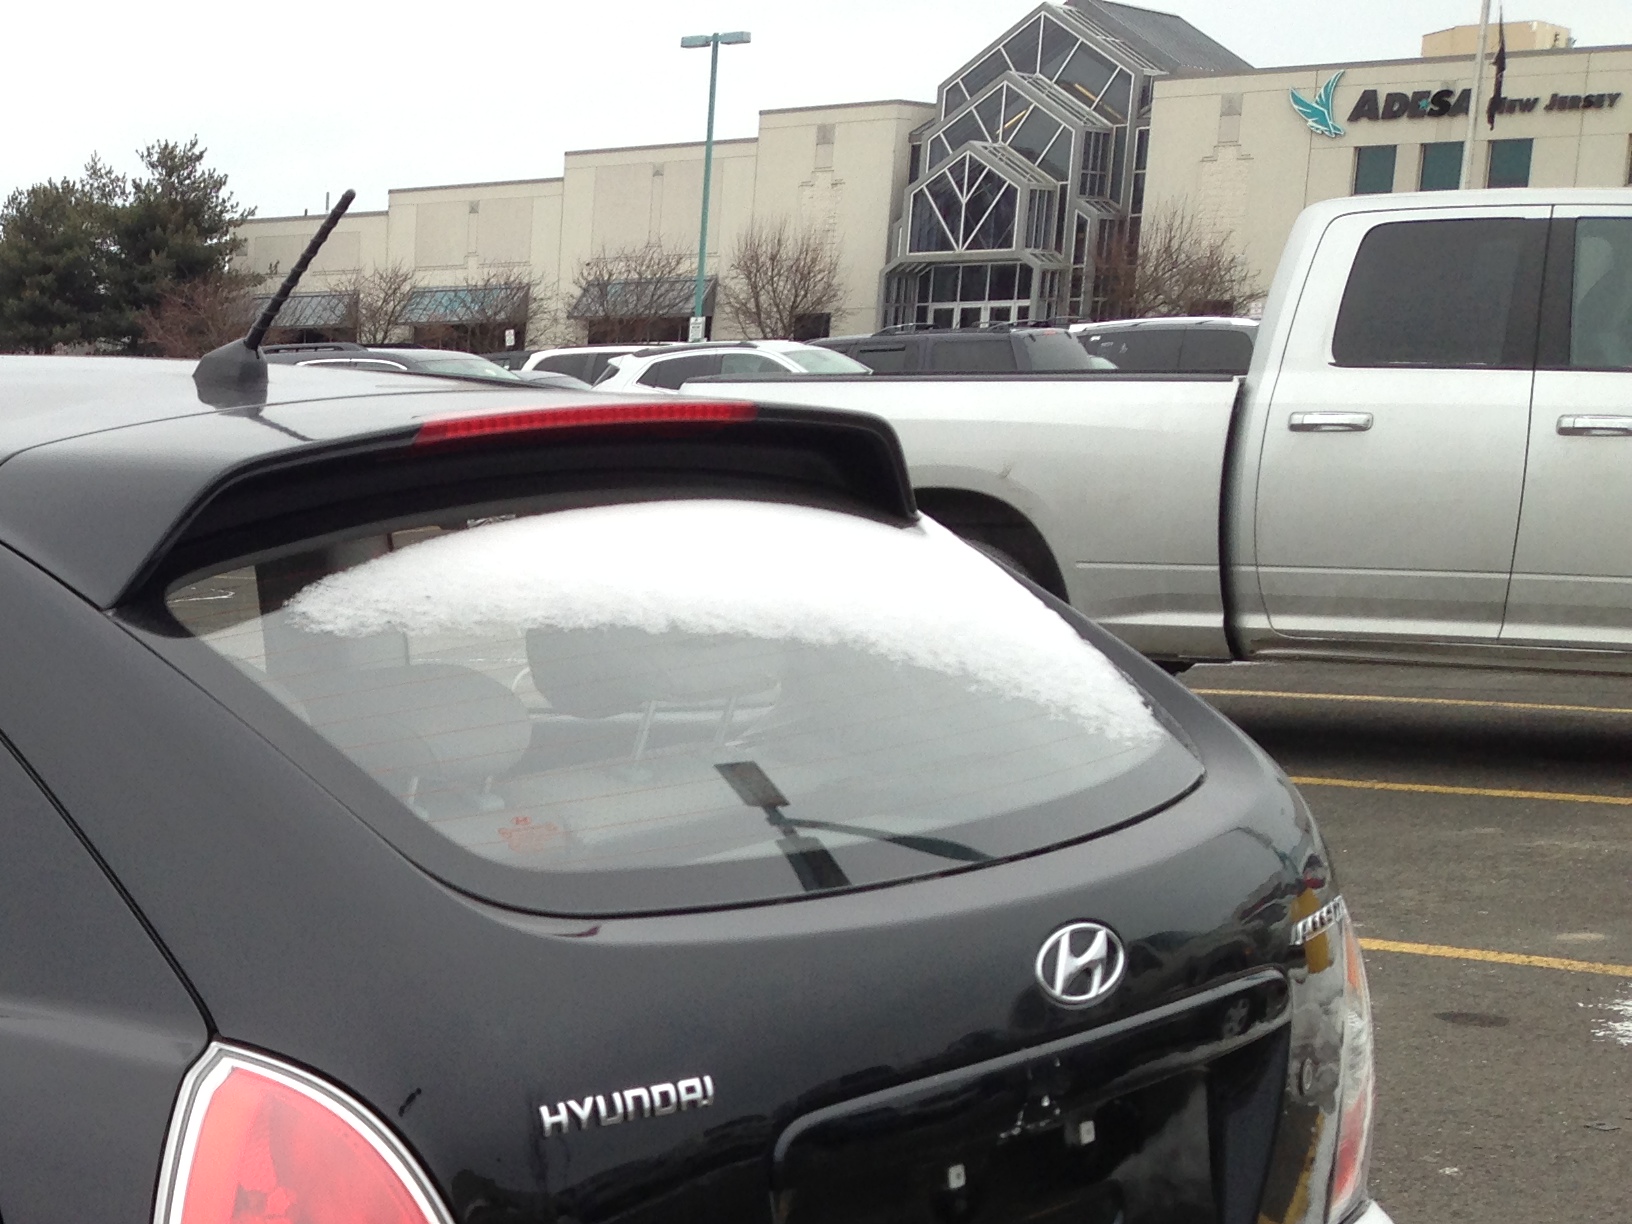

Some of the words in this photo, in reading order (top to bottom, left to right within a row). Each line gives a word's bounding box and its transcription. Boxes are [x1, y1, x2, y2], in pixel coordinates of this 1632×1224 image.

[1347, 88, 1472, 122] ADESA
[1543, 92, 1622, 112] JERSEY
[539, 1074, 715, 1137] HYUNDAI
